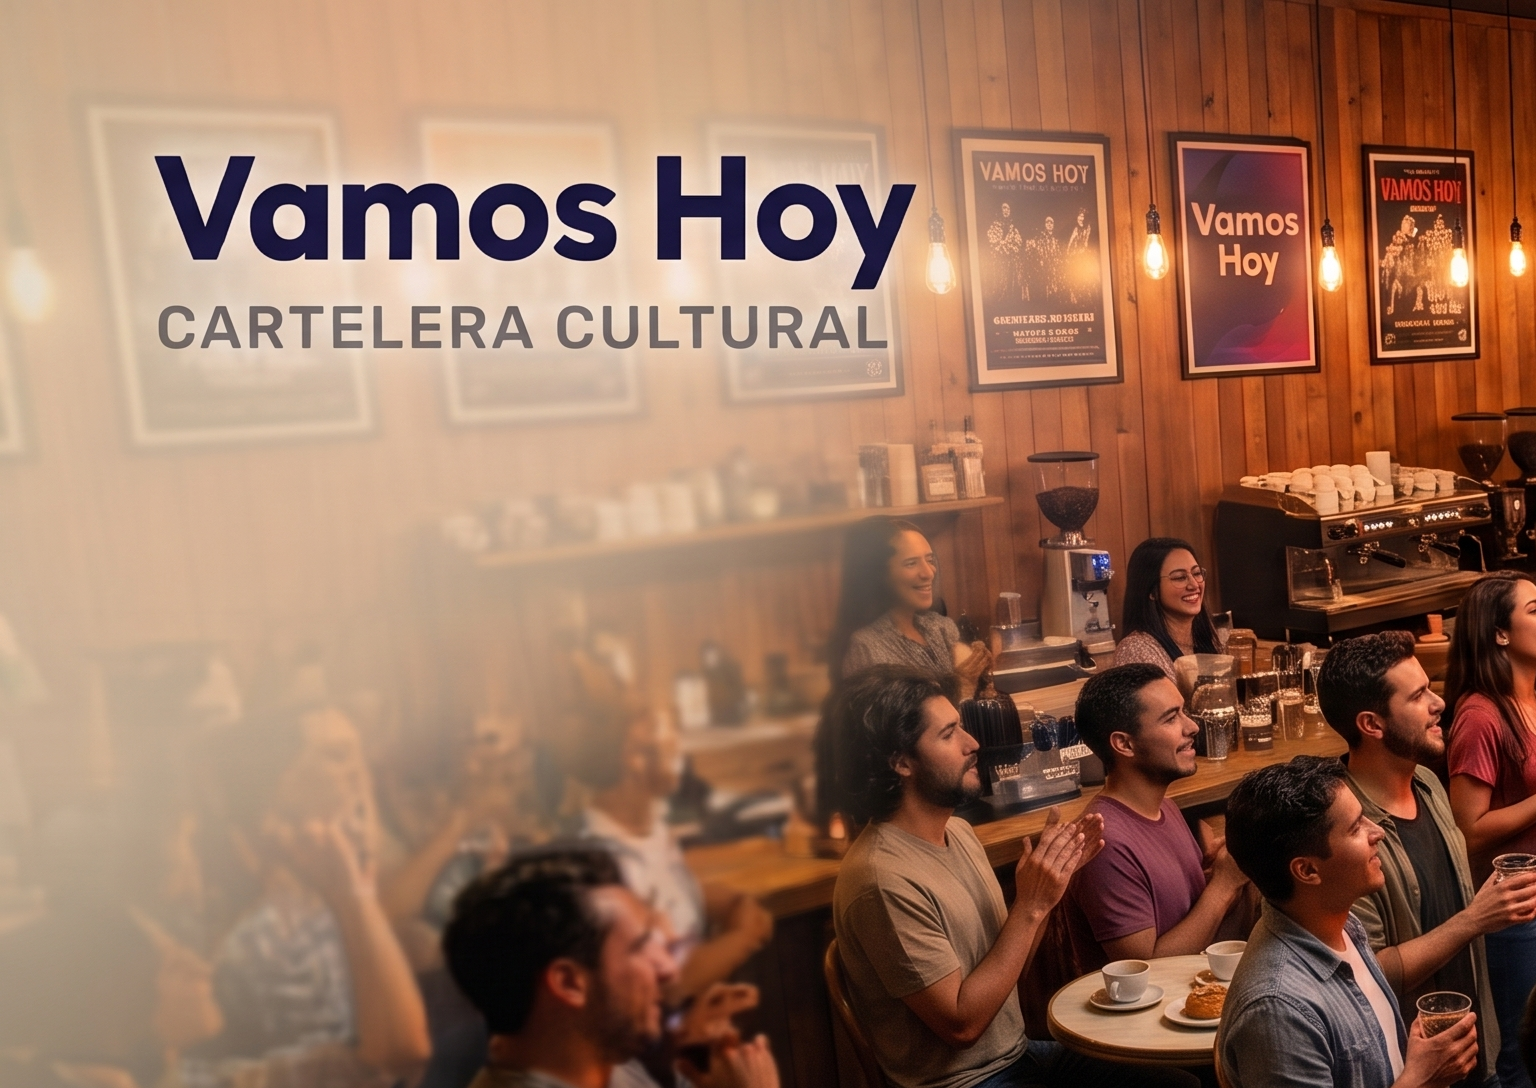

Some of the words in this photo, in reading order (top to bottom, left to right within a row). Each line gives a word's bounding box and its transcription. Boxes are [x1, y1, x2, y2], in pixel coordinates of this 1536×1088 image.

[980, 161, 1047, 183] VAMOS
[1053, 163, 1089, 184] HOY
[1381, 177, 1432, 202] VAMOS
[1191, 202, 1299, 237] Vamos
[1218, 243, 1280, 286] Hoy
